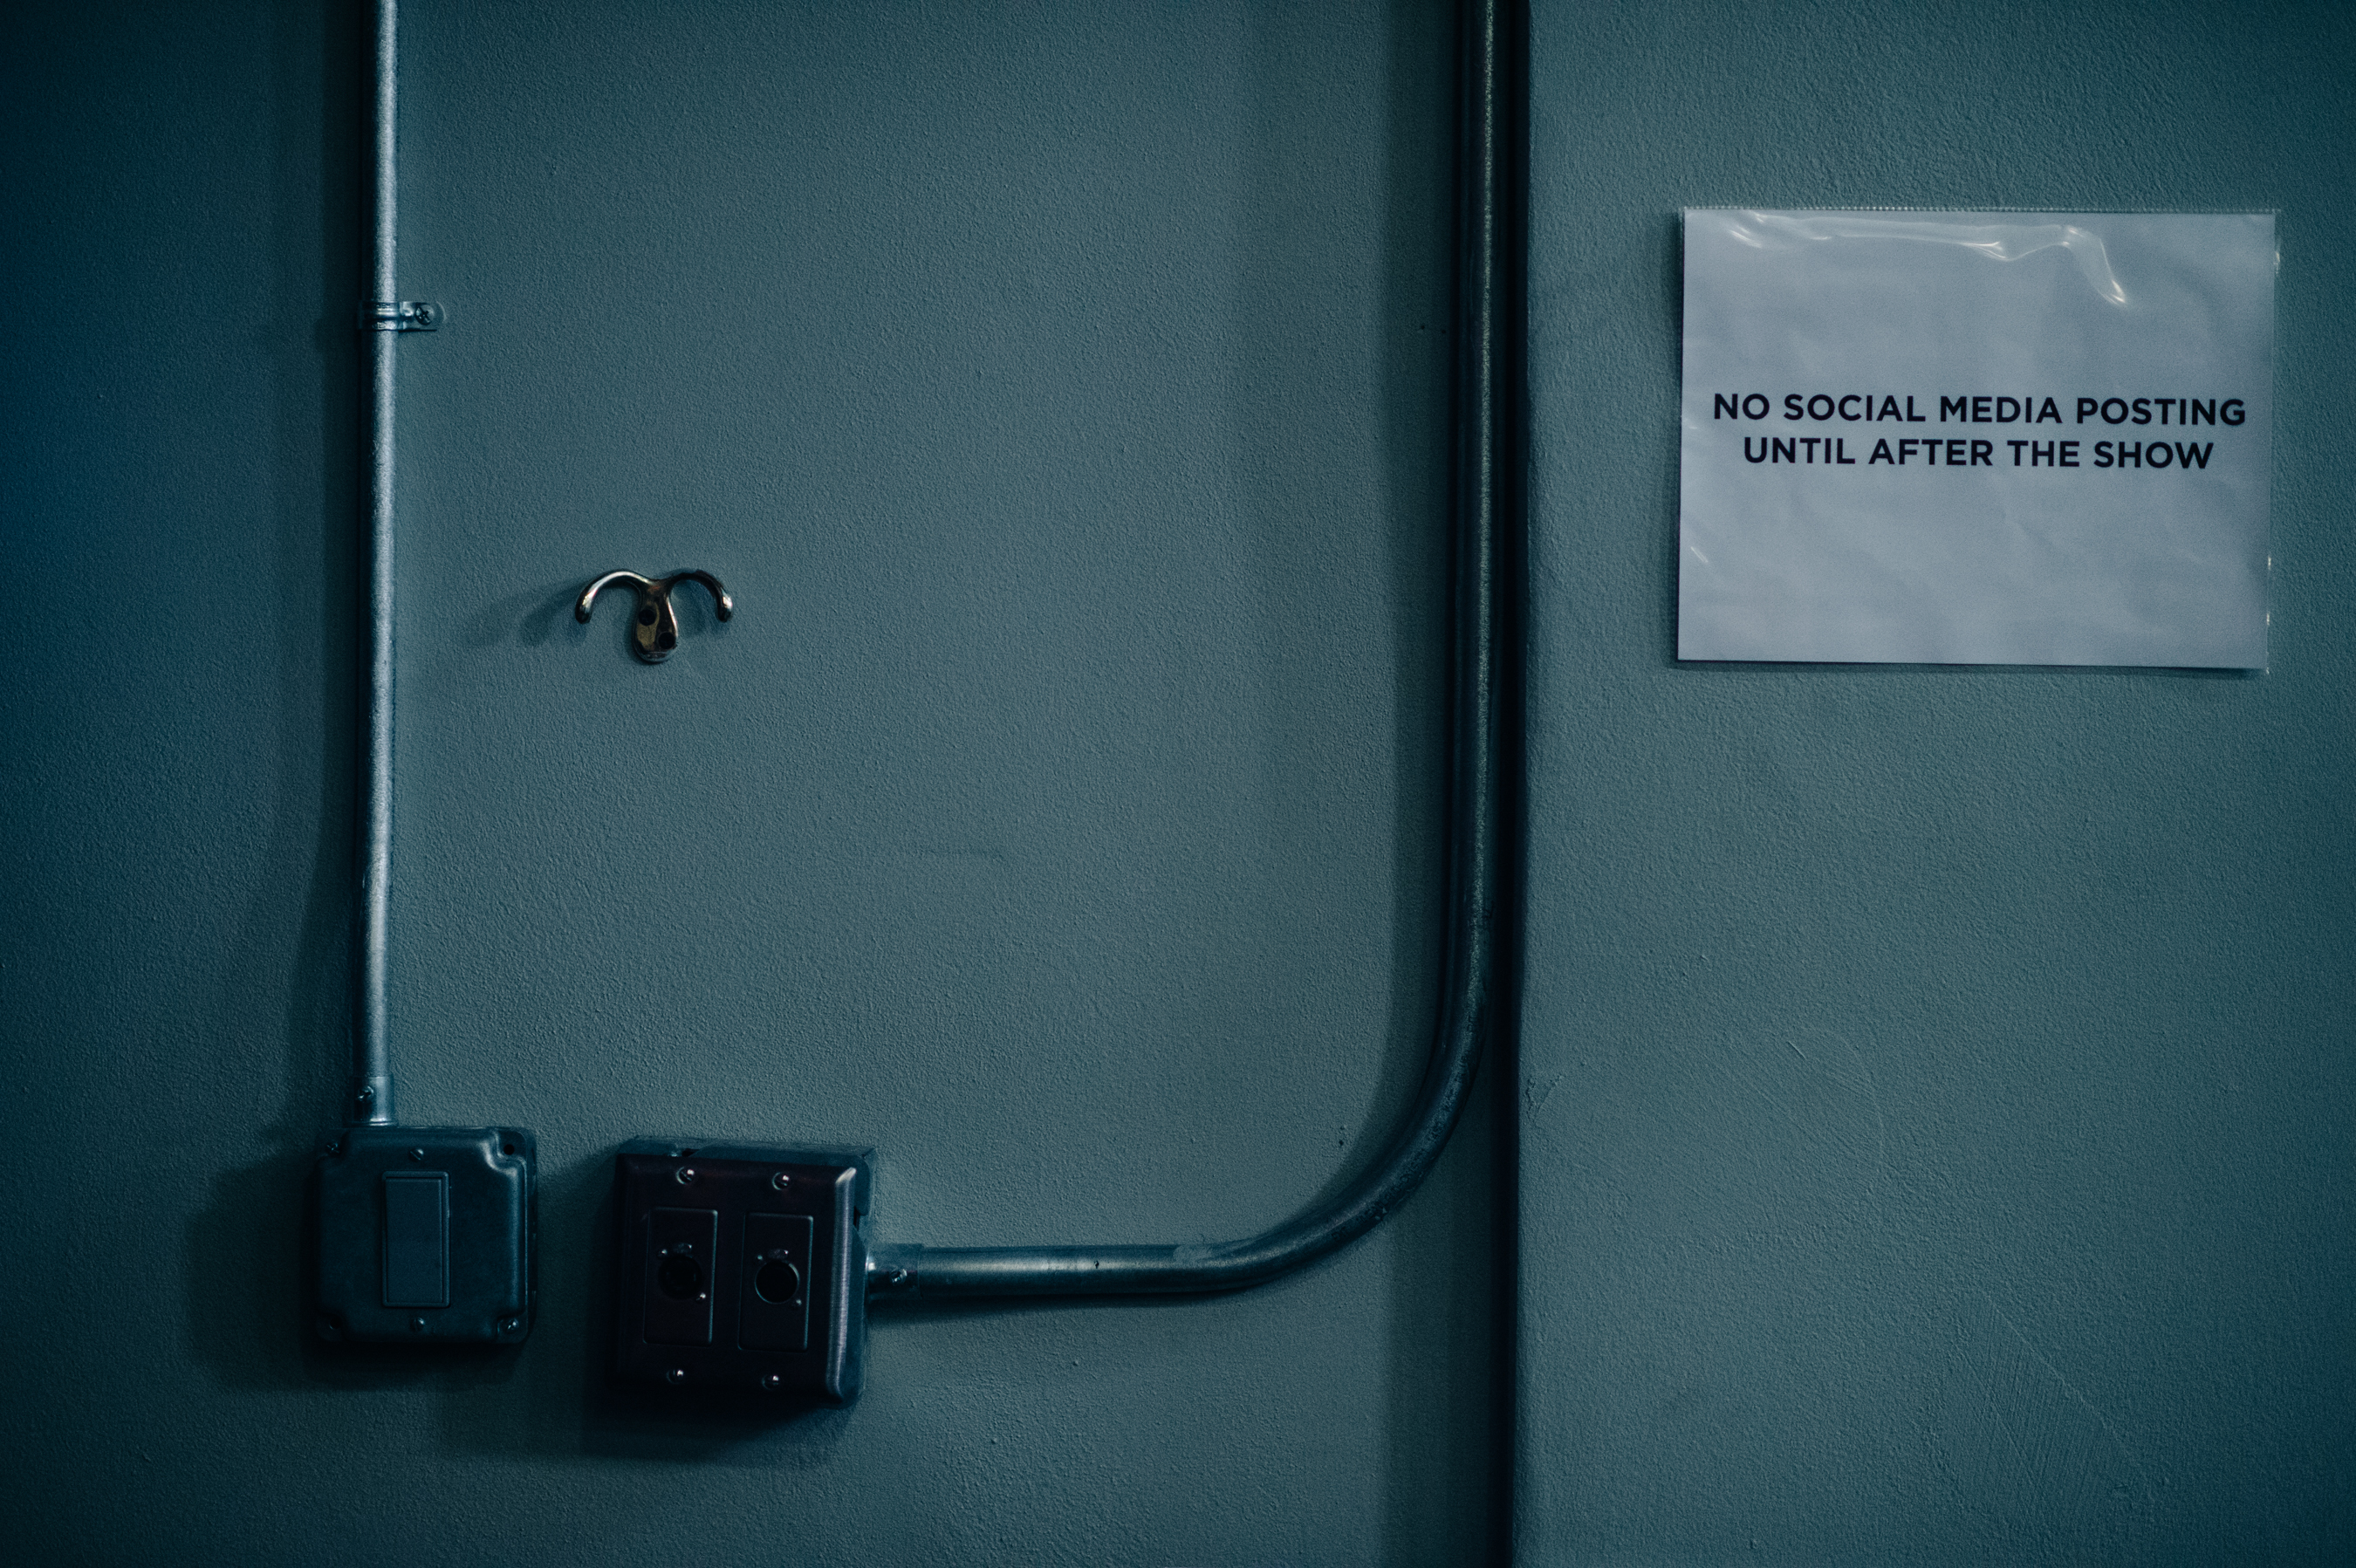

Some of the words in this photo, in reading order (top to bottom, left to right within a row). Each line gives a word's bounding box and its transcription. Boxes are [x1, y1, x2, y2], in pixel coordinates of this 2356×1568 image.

[1713, 393, 1770, 421] NO
[1783, 394, 1927, 422] SOCIAL
[1940, 395, 2064, 424] MEDIA
[2076, 396, 2247, 426] POSTING
[1743, 437, 1856, 465] UNTIL
[1867, 438, 1994, 467] AFTER
[2006, 439, 2080, 468] THE
[2092, 441, 2215, 469] SHOW
